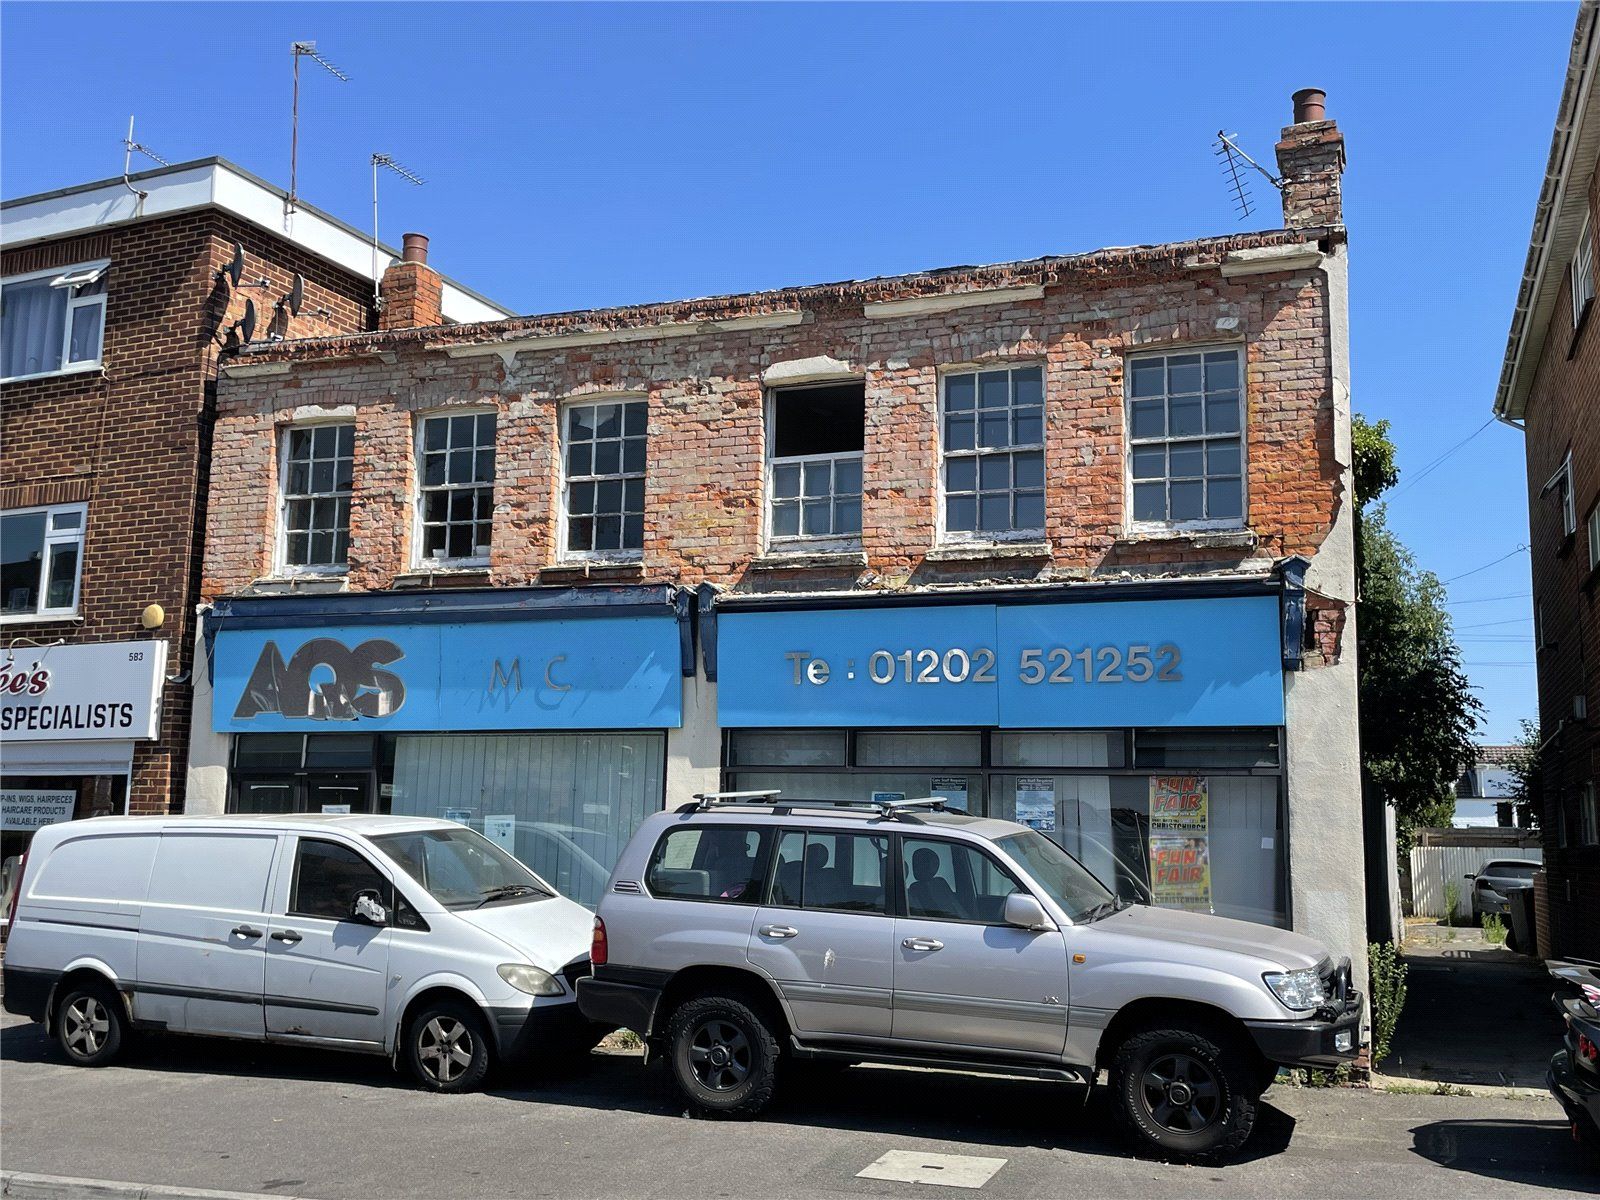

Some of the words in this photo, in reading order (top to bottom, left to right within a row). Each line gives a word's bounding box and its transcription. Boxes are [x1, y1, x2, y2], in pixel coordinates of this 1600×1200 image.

[128, 652, 144, 662] 583
[784, 651, 830, 685] Te
[869, 648, 996, 684] 01202
[1019, 644, 1183, 685] 521252
[231, 637, 406, 722] AQS
[1, 702, 133, 730] SPECIALISTS
[1156, 776, 1197, 793] FUN
[37, 795, 73, 804] HAIRPIECES
[1154, 794, 1201, 811] FAIR
[2, 805, 33, 814] HAIRCARE
[33, 806, 66, 815] PRODUCTS
[5, 817, 37, 826] AVAILABLE
[1156, 849, 1197, 865] FUN
[1156, 866, 1203, 884] FAIR
